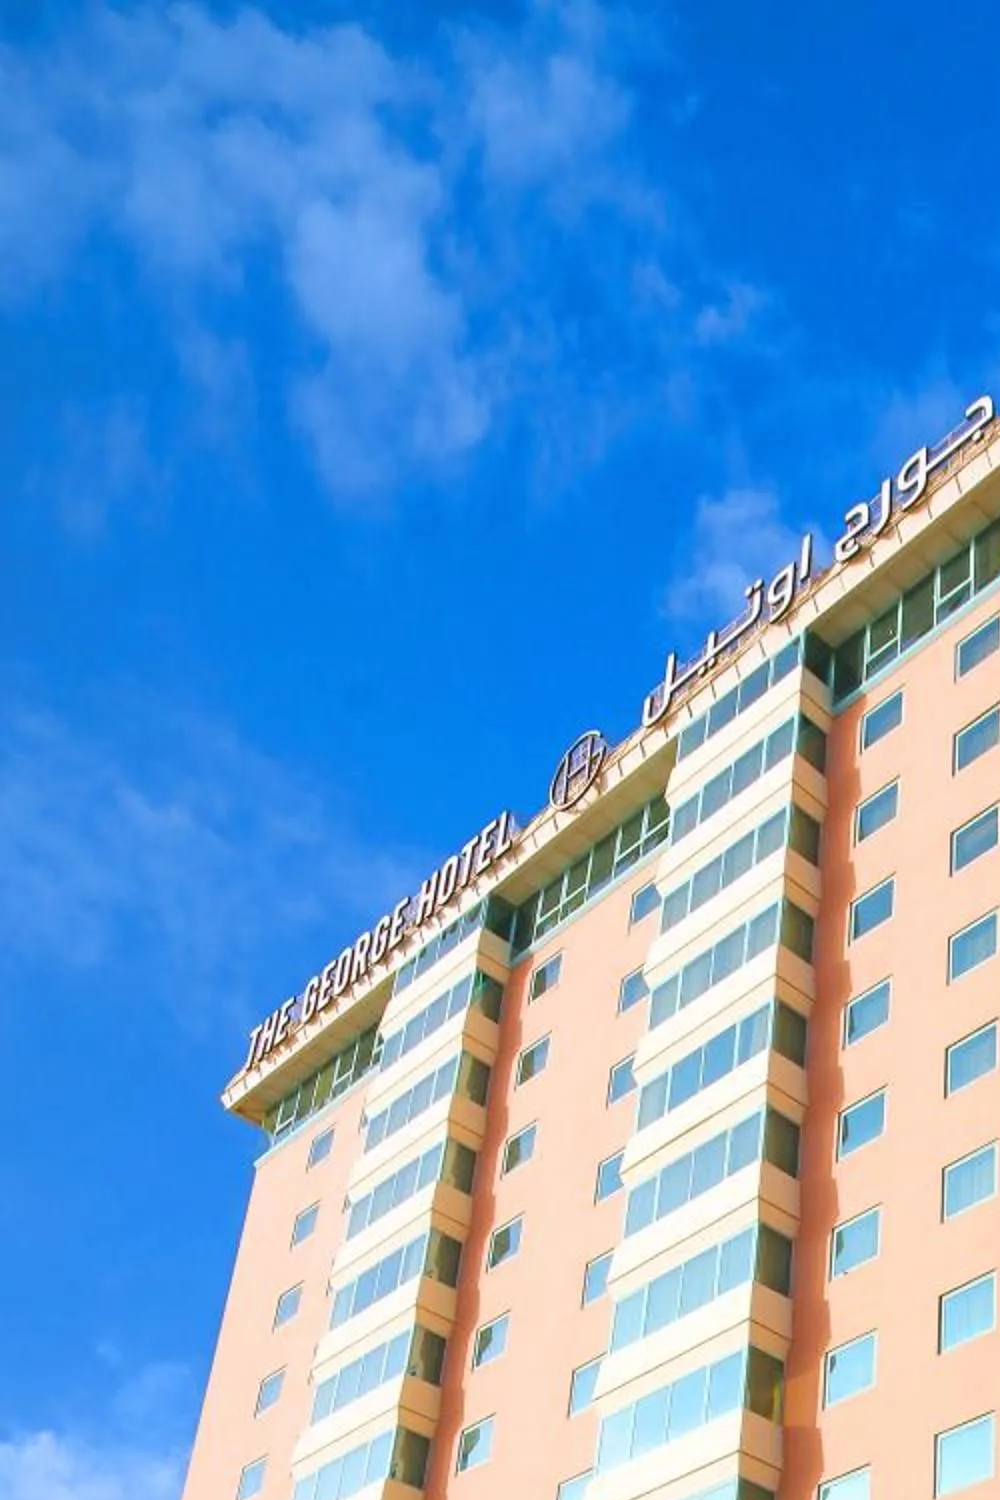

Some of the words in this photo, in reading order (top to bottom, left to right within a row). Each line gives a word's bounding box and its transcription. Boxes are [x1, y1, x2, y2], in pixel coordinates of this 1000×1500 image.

[835, 395, 994, 562] جورج
[642, 532, 813, 729] اوتيل
[246, 996, 298, 1071] THE
[300, 896, 411, 1025] GEORGE
[416, 809, 512, 926] HOTEL
